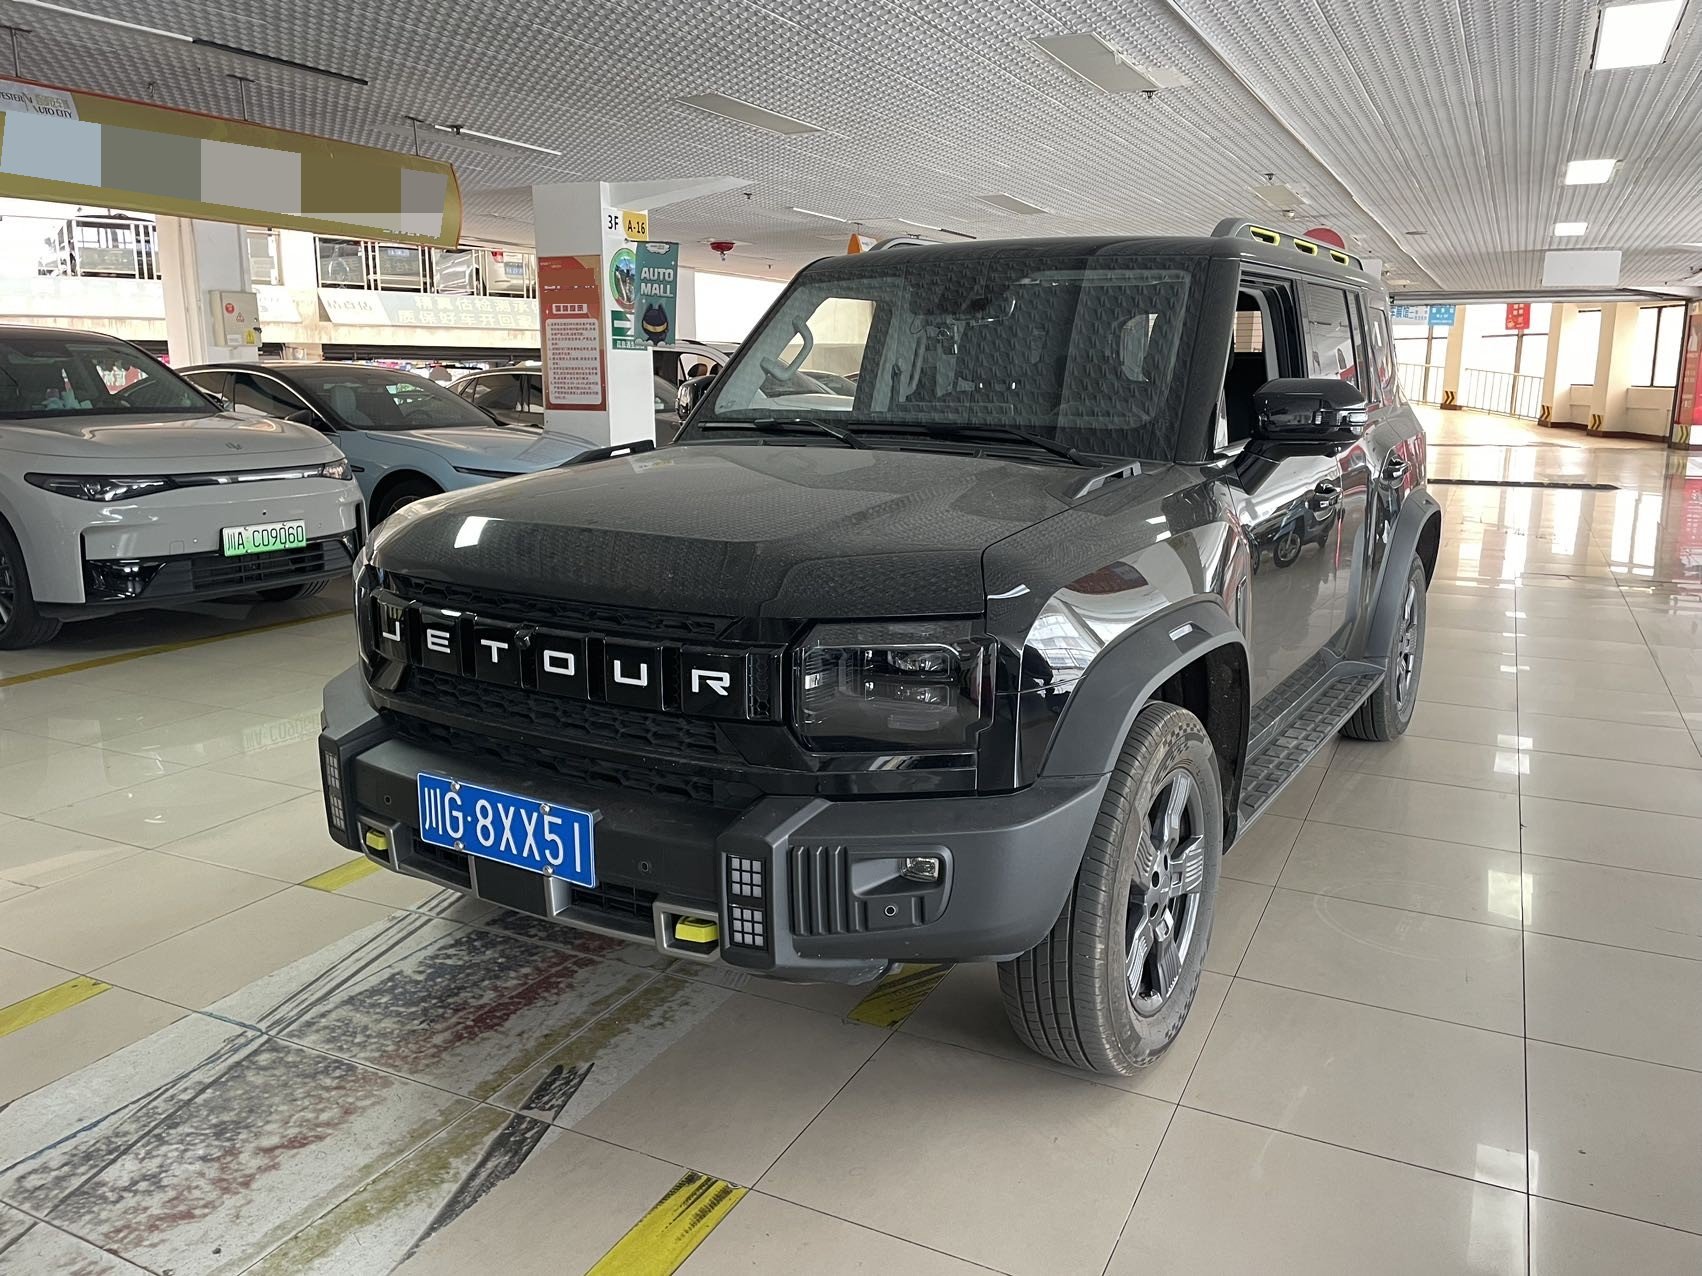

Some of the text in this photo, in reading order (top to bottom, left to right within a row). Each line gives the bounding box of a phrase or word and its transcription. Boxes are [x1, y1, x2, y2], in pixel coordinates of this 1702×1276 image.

[33, 105, 73, 119] AUTO CITY
[608, 214, 646, 235] 3F A-16
[640, 267, 674, 282] AUTO
[640, 282, 674, 297] MALL
[227, 525, 305, 551] 川A C09060
[382, 620, 730, 696] JETOUR
